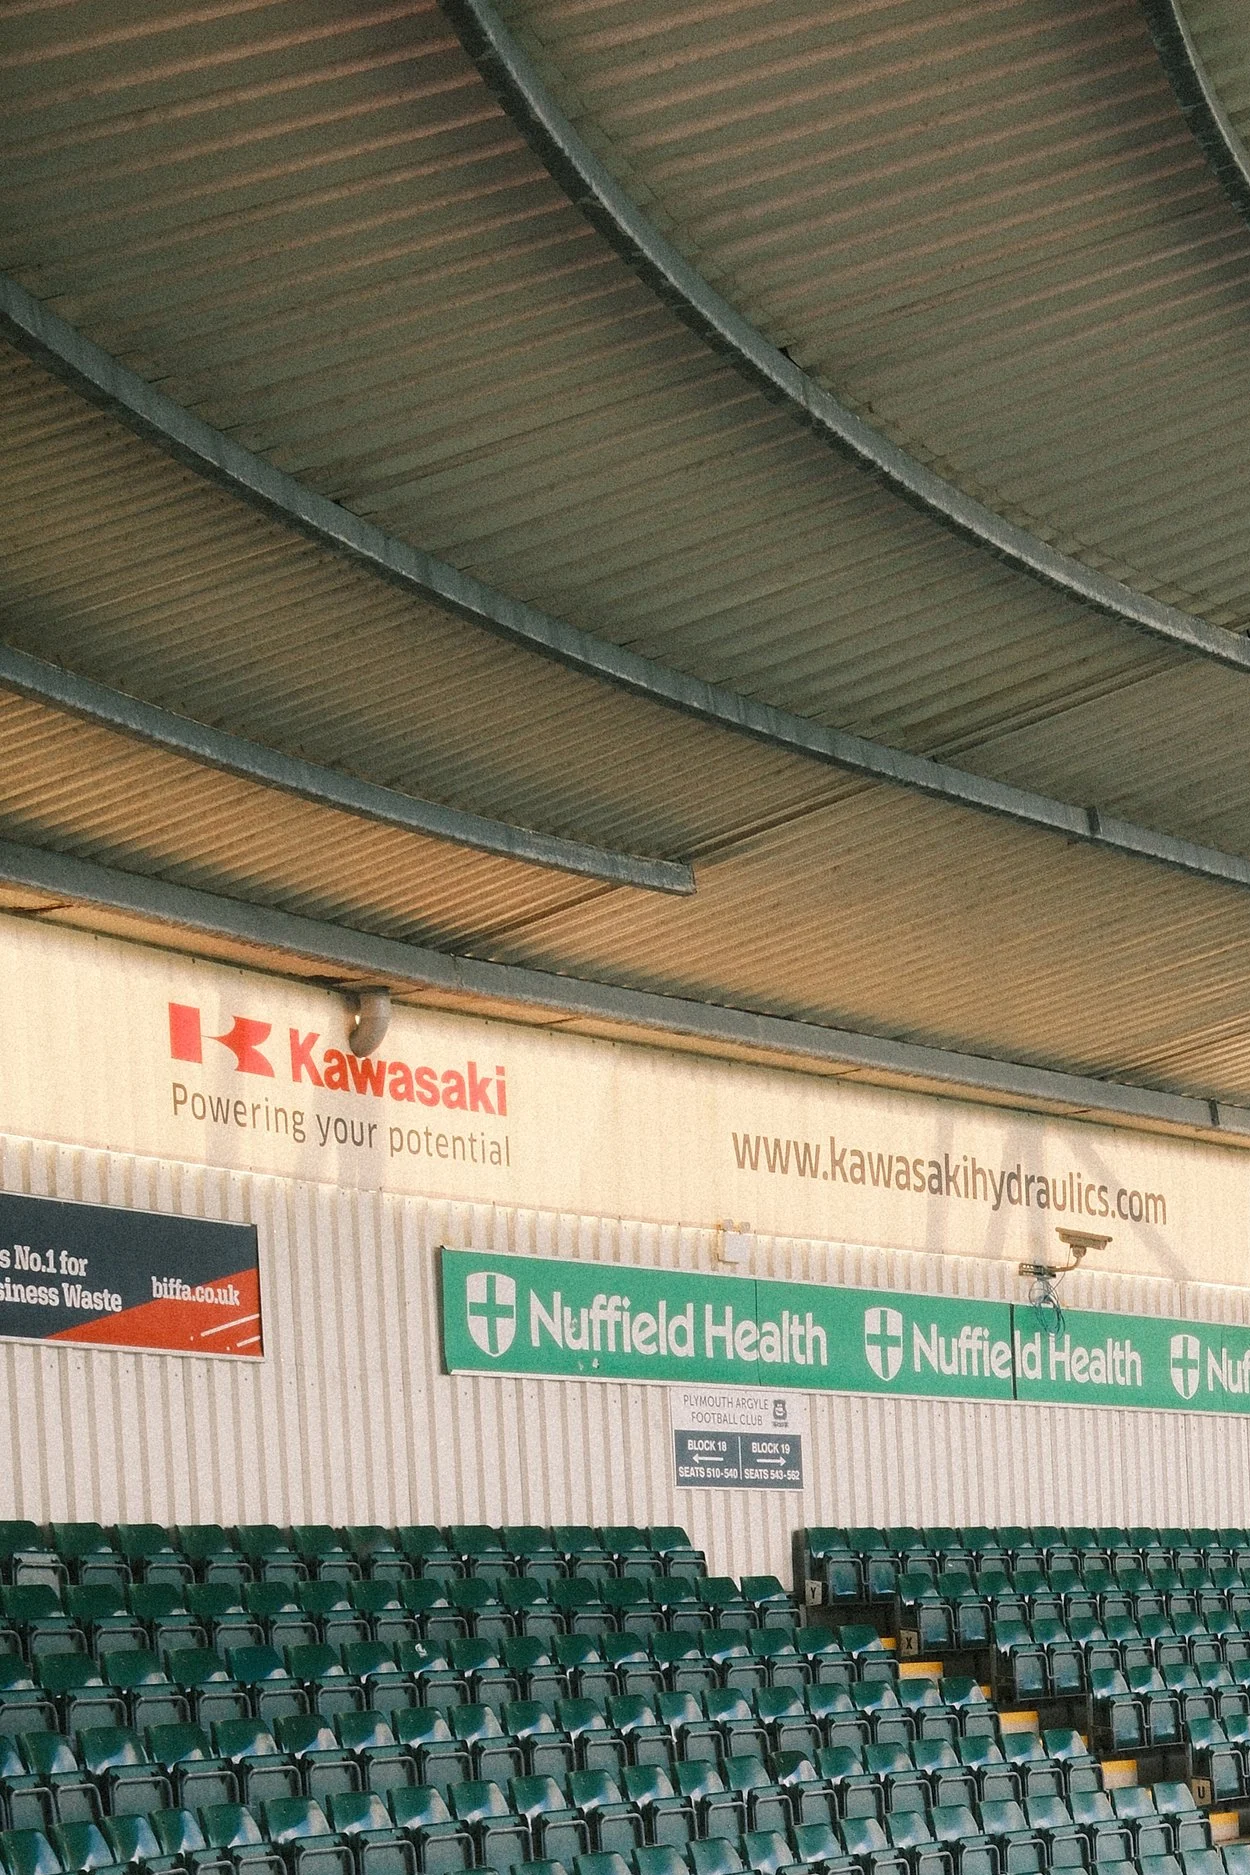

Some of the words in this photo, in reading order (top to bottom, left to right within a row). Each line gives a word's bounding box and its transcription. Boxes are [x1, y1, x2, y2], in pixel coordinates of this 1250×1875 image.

[289, 1027, 508, 1117] Kawasaki
[171, 1082, 306, 1144] Powering
[315, 1110, 378, 1149] your
[389, 1122, 512, 1168] potential
[731, 1132, 1167, 1225] www.kawasakihydraulics.com
[14, 1245, 57, 1273] No.1
[59, 1250, 88, 1276] for
[62, 1283, 122, 1312] Waste
[151, 1276, 240, 1306] biffa.co.uk
[529, 1289, 694, 1358] Nuffield
[705, 1304, 828, 1365] Health
[913, 1322, 1042, 1381] Nuffield
[1048, 1332, 1142, 1387] Health
[683, 1394, 733, 1408] PLYMOUTH
[736, 1398, 769, 1410] ARGYLE
[691, 1411, 738, 1425] FOOTBALL
[740, 1414, 763, 1426] CLUB
[687, 1440, 716, 1451] BLOCK
[717, 1441, 727, 1452] 18
[751, 1442, 779, 1453] BLOCK
[781, 1444, 791, 1454] 19
[678, 1466, 705, 1478] SEATS
[706, 1467, 738, 1479] 510-540
[744, 1468, 769, 1480] SEATS
[810, 1587, 817, 1600] Y
[905, 1636, 913, 1650] X
[1197, 1785, 1206, 1799] U
